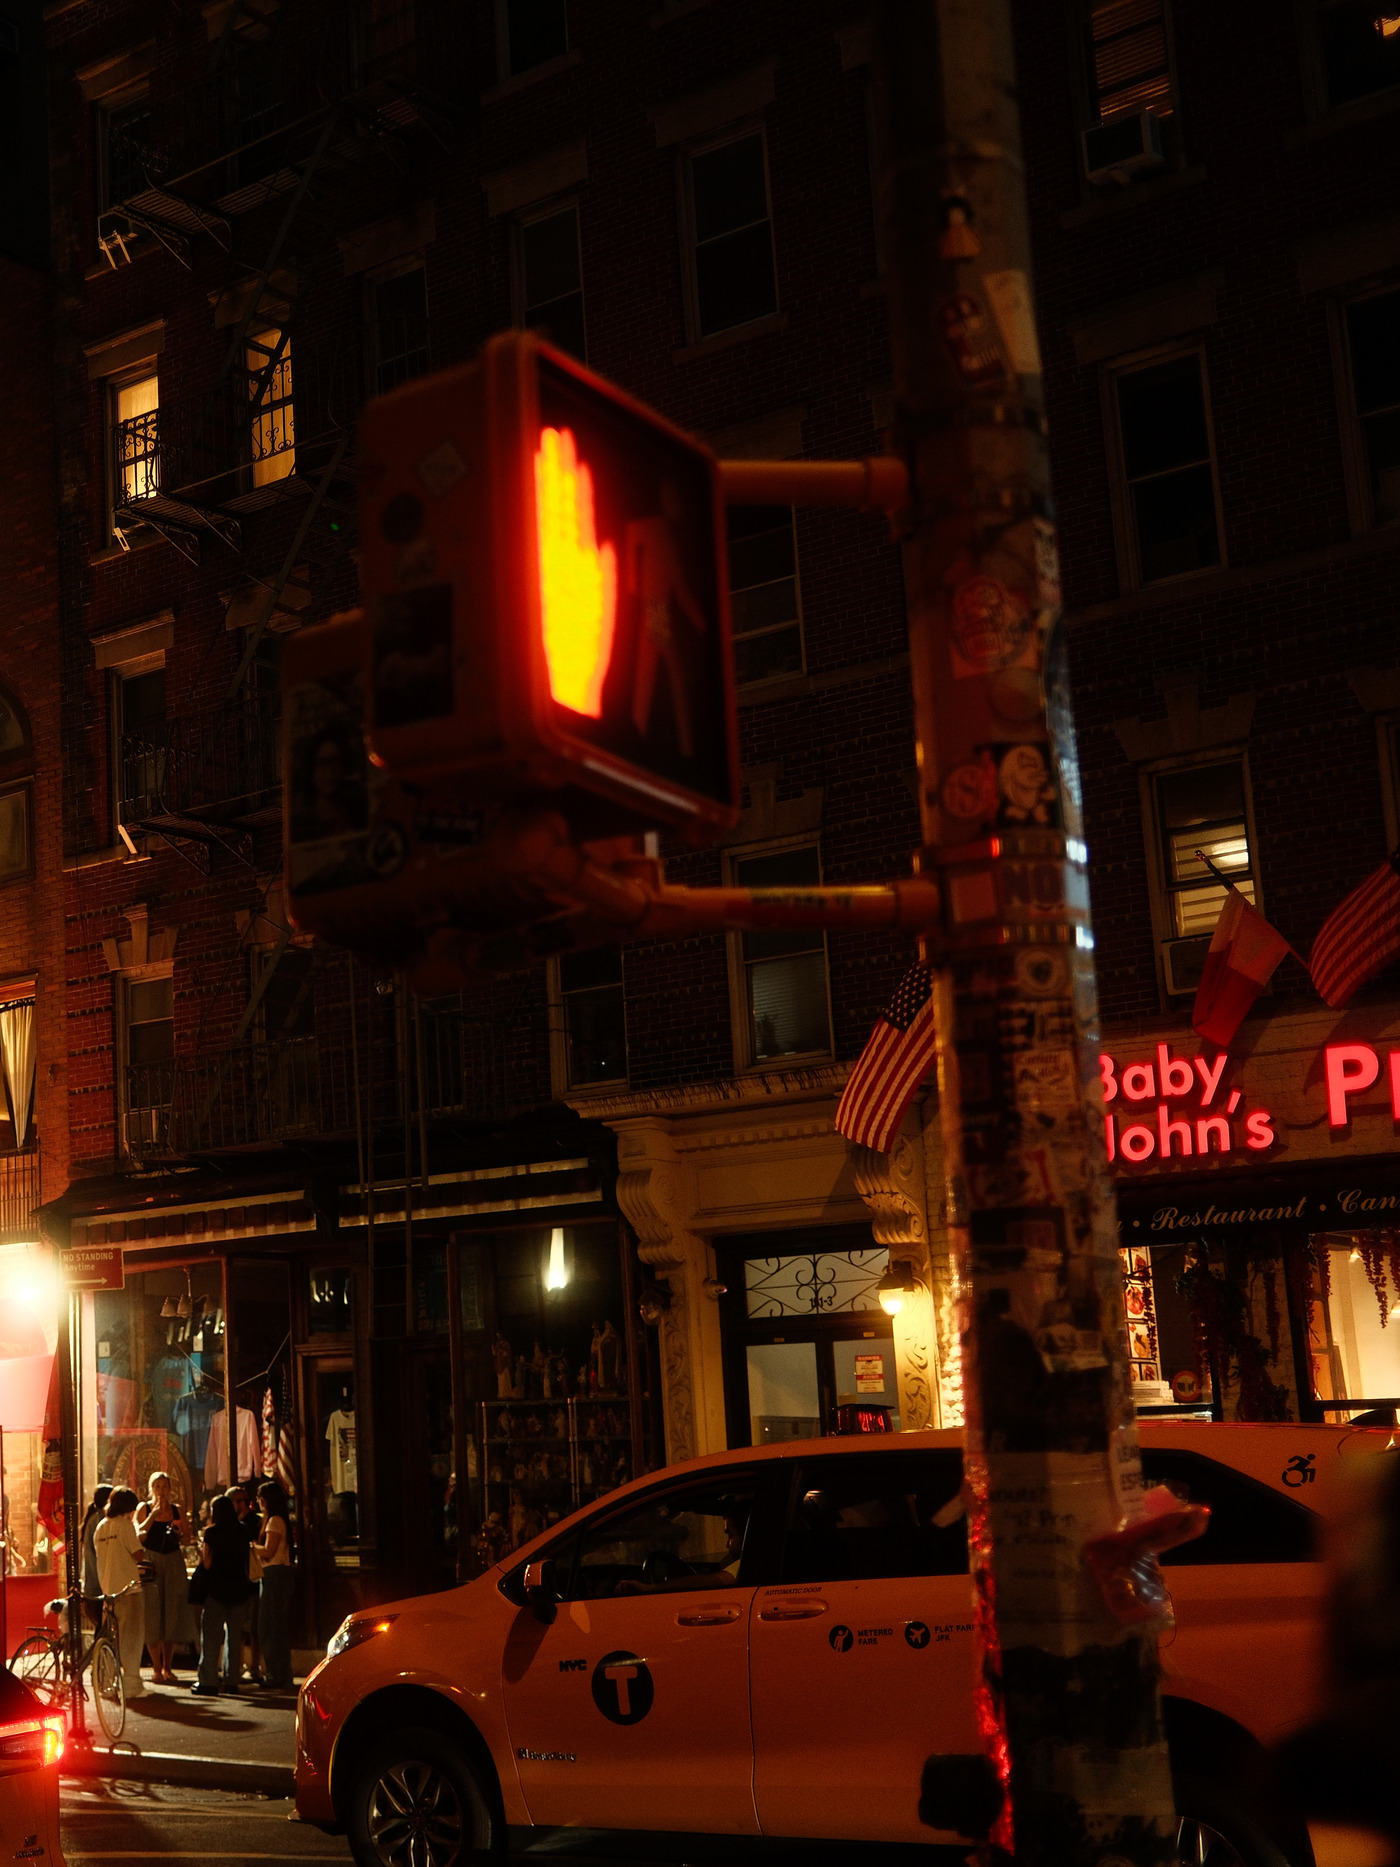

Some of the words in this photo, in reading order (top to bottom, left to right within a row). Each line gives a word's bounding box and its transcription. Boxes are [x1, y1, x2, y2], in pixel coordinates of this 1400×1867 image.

[1151, 1197, 1308, 1231] Restaurant
[1336, 1188, 1400, 1214] Can
[63, 1253, 74, 1261] NO
[75, 1251, 114, 1261] STANDING
[63, 1263, 96, 1272] Anytime
[857, 1628, 894, 1638] METERED
[934, 1625, 953, 1634] FLAT
[858, 1637, 879, 1645] FARE
[936, 1634, 951, 1642] JFK
[559, 1659, 587, 1672] NYC
